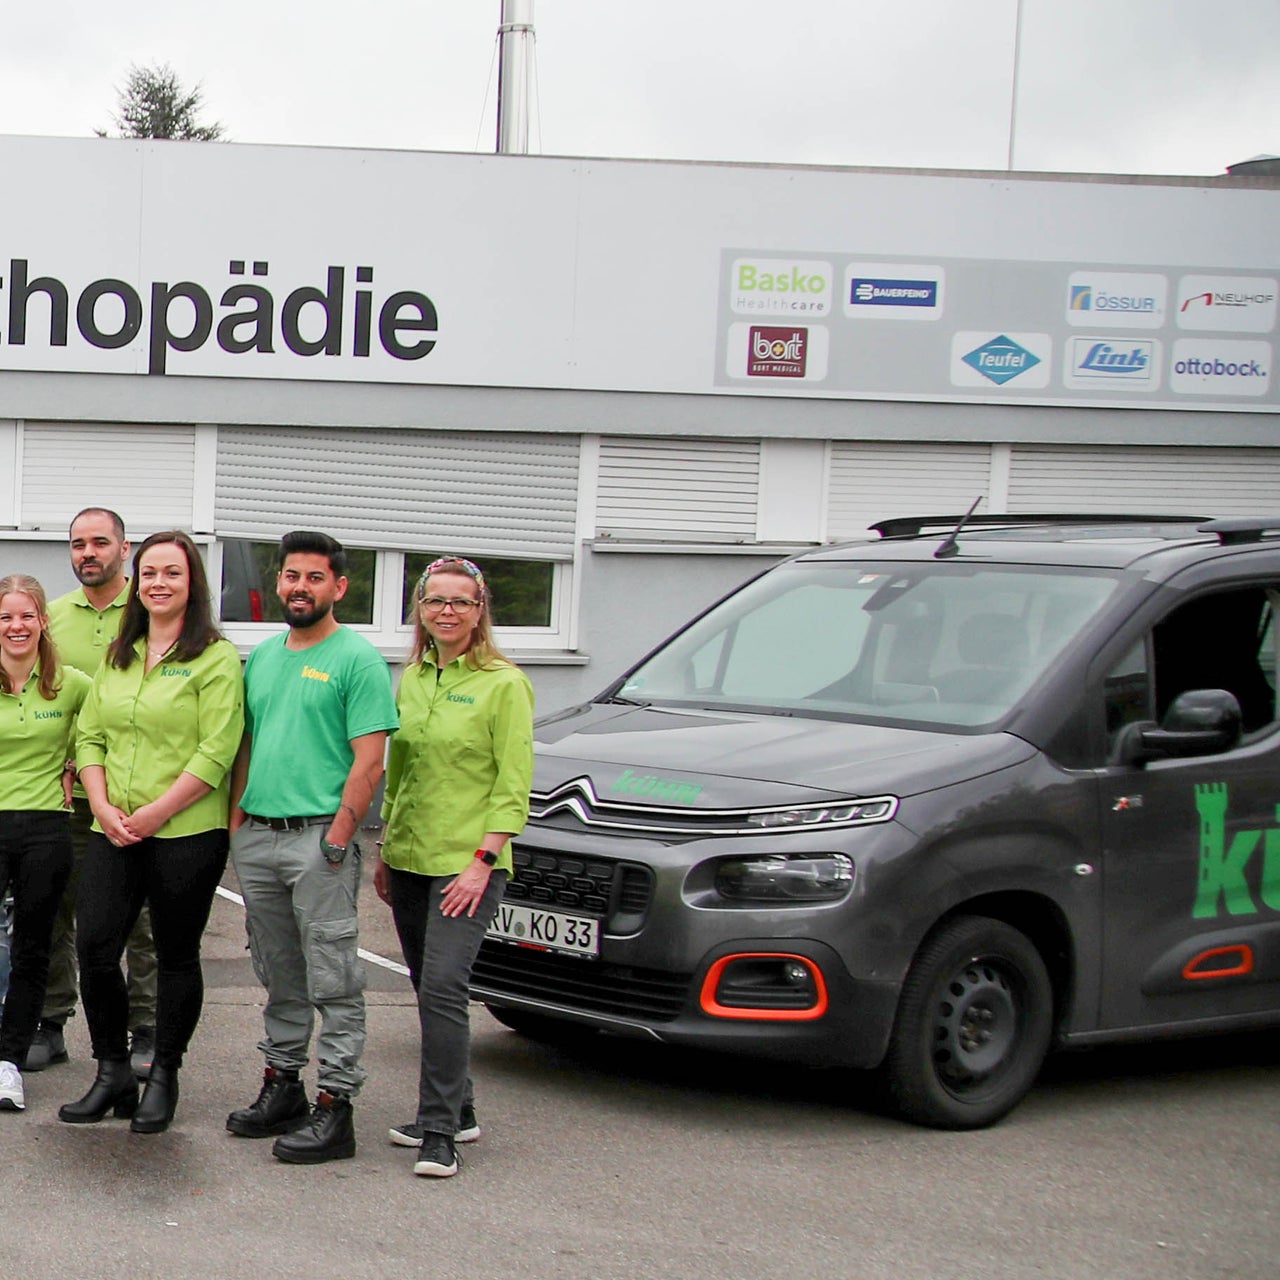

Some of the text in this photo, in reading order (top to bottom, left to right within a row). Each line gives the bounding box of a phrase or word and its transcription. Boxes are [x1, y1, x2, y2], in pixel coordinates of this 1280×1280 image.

[738, 264, 827, 294] Basko
[873, 288, 929, 300] BAUERFEIND
[1095, 291, 1155, 310] ÖSSUR
[1214, 291, 1275, 304] NEUHOF
[736, 297, 825, 312] Healthcare
[978, 352, 1026, 369] Teufel
[530, 912, 557, 942] KO
[564, 919, 592, 948] 33
